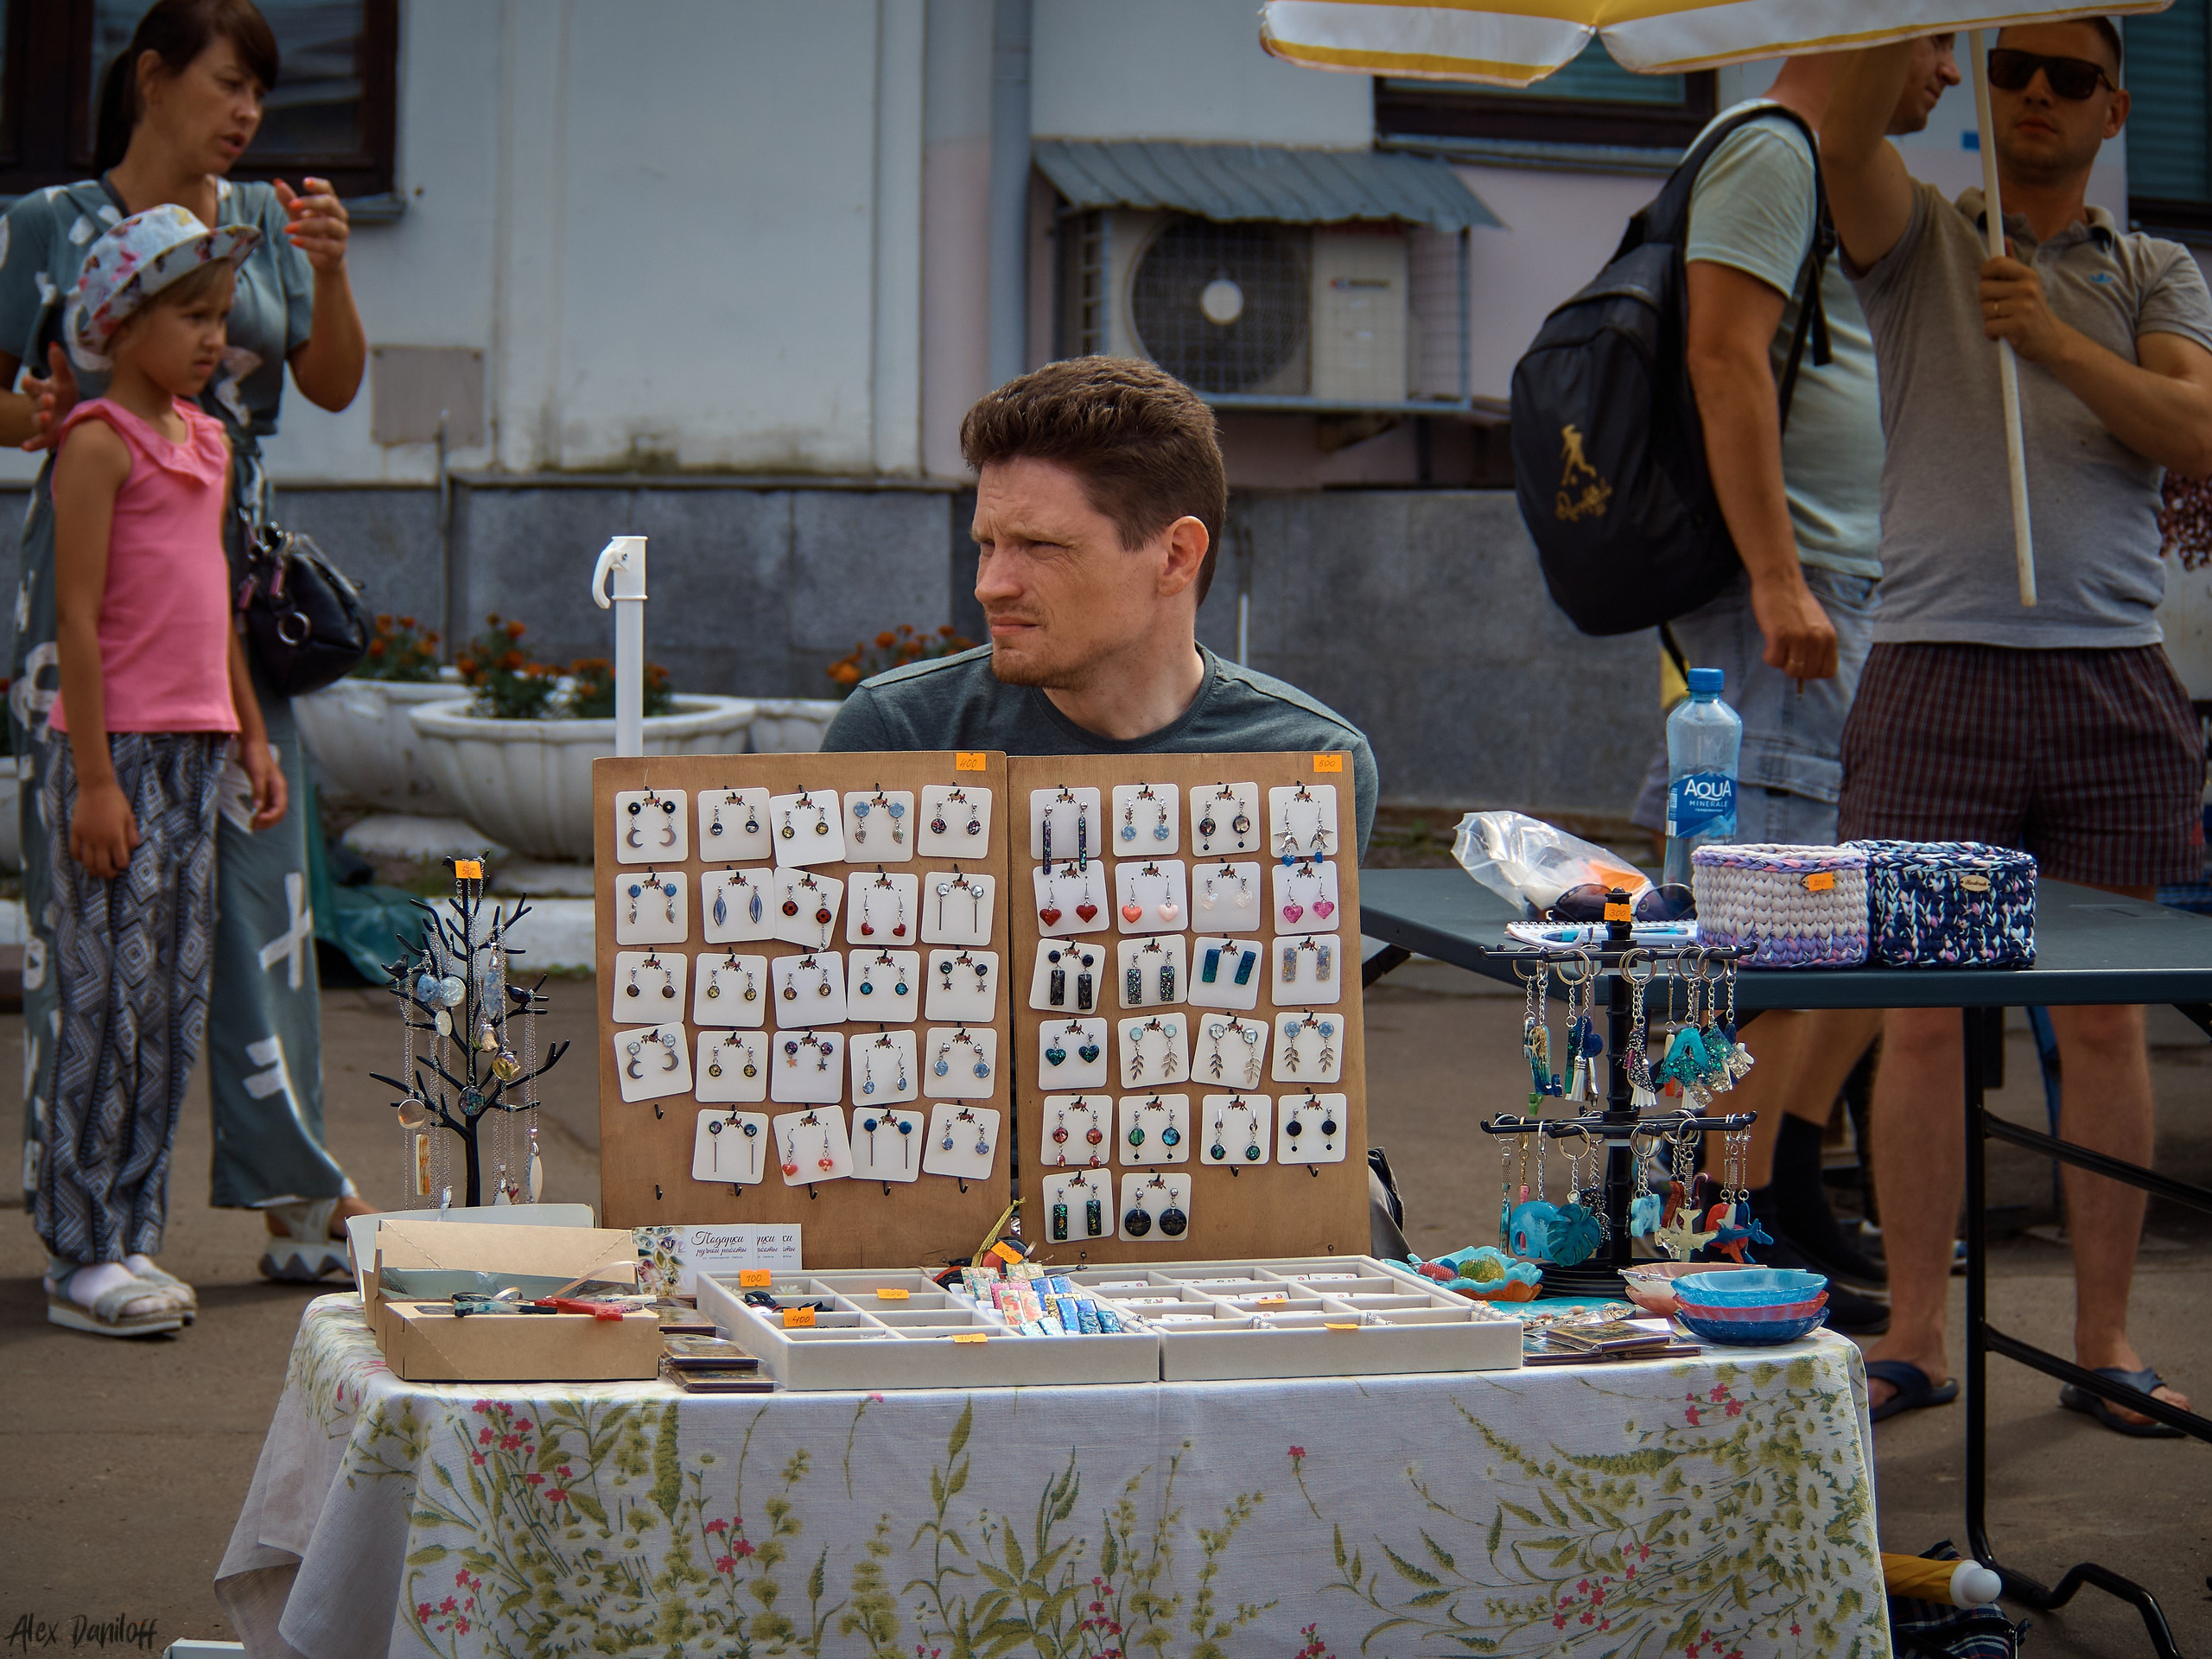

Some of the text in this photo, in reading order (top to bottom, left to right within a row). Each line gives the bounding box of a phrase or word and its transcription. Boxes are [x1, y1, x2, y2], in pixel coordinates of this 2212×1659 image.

[1318, 759, 1336, 768] 500
[1683, 779, 1732, 799] AQUA
[1609, 908, 1626, 918] 300
[690, 1230, 744, 1249] Подарки
[792, 1314, 810, 1325] 400
